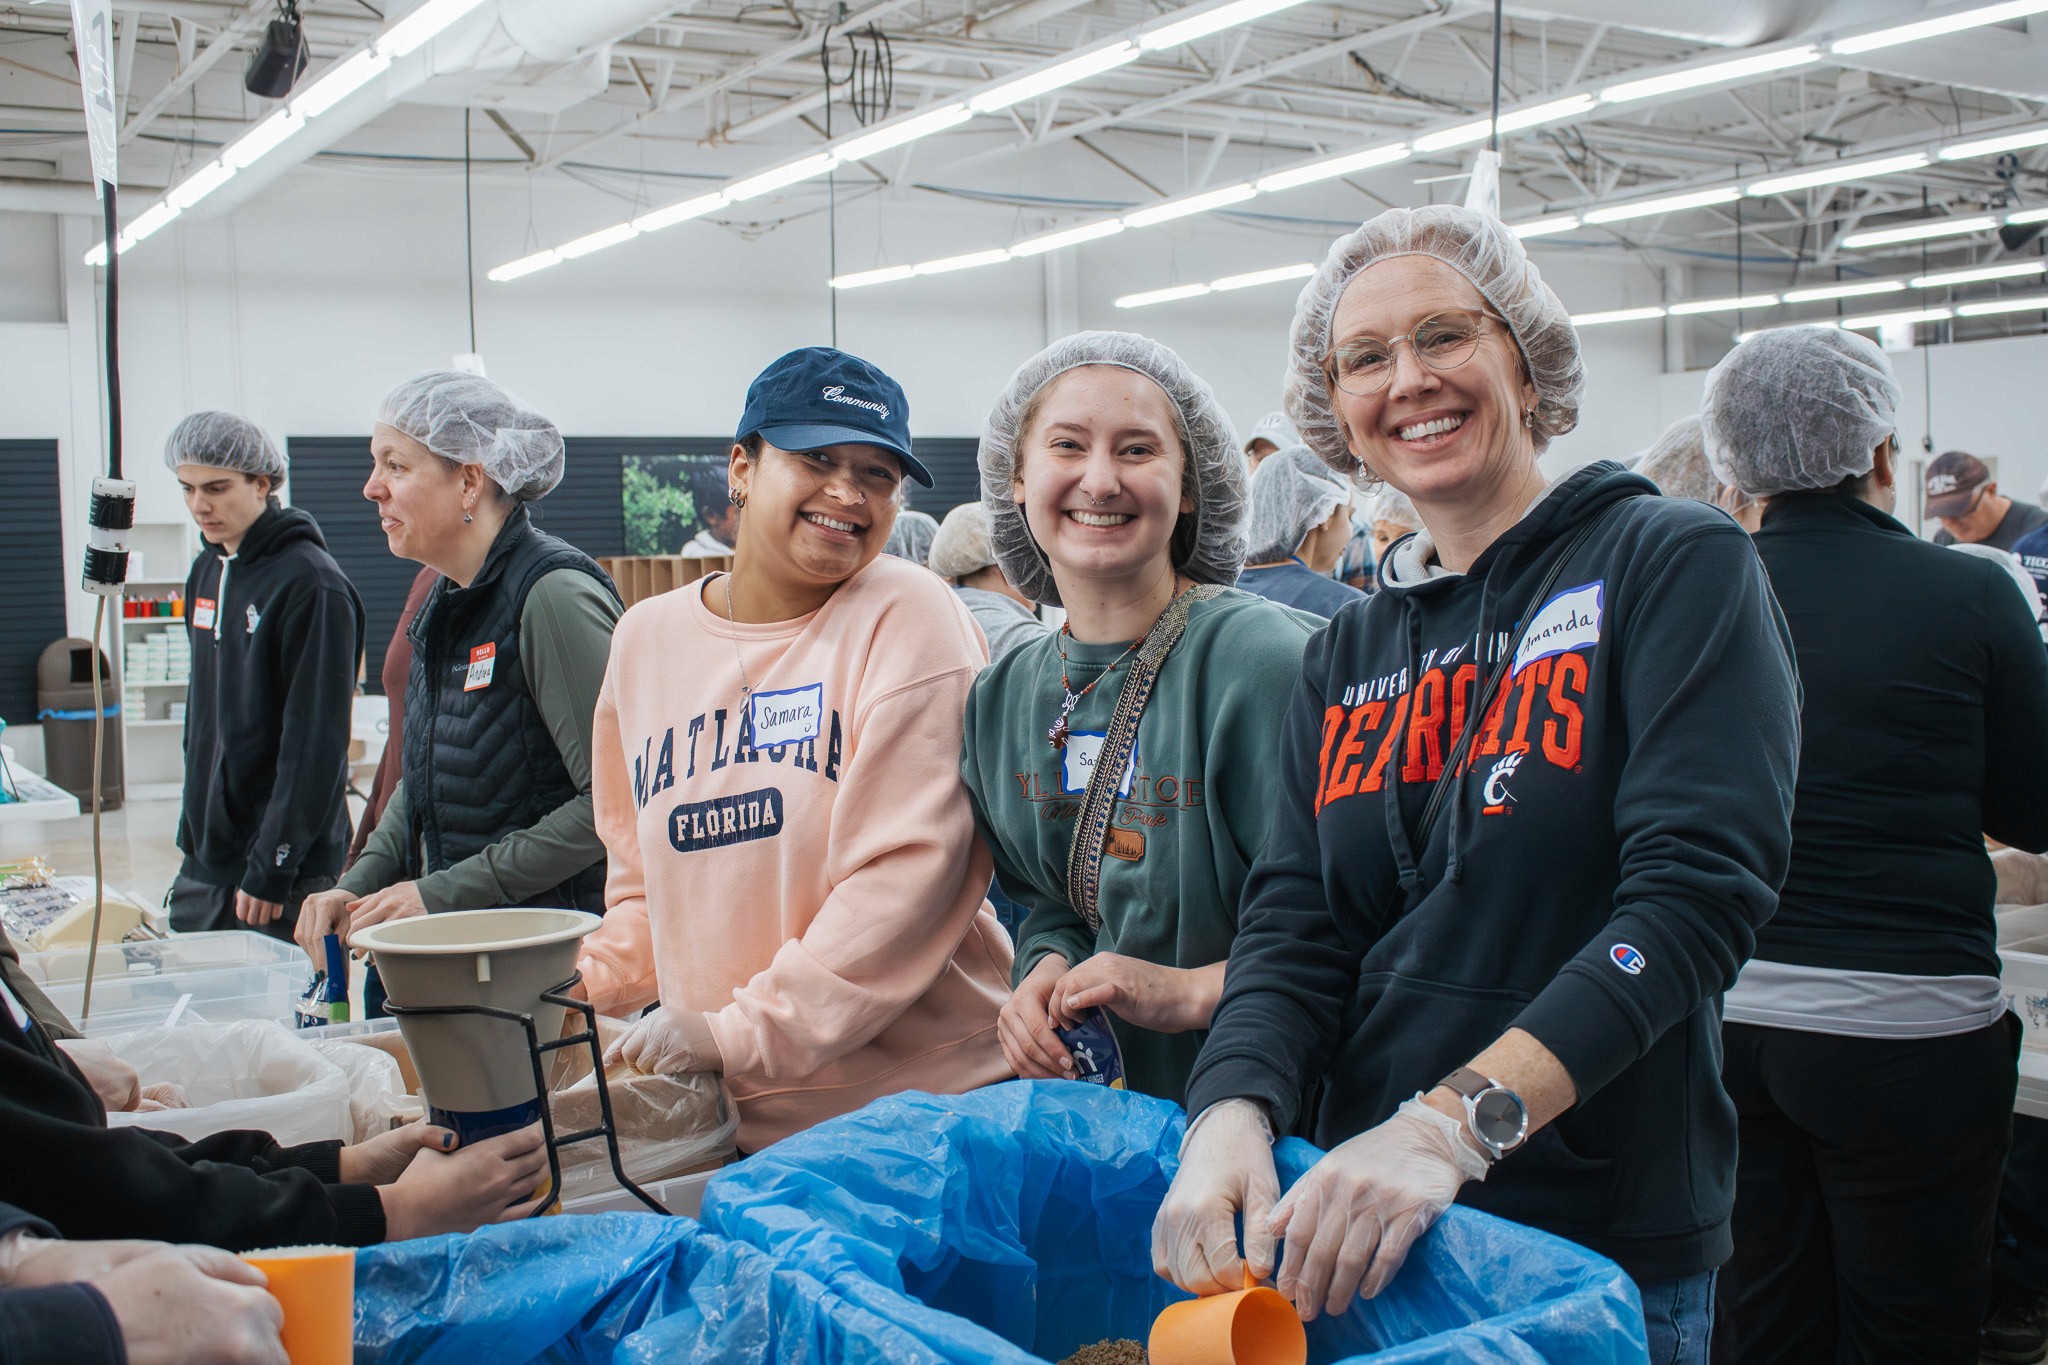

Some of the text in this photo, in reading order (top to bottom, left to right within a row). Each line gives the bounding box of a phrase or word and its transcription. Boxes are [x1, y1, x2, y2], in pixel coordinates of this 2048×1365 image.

[823, 386, 890, 419] Community
[1522, 610, 1593, 656] Amanda
[476, 647, 491, 656] HELLO
[761, 705, 812, 730] Samara
[676, 798, 777, 842] FLORIDA
